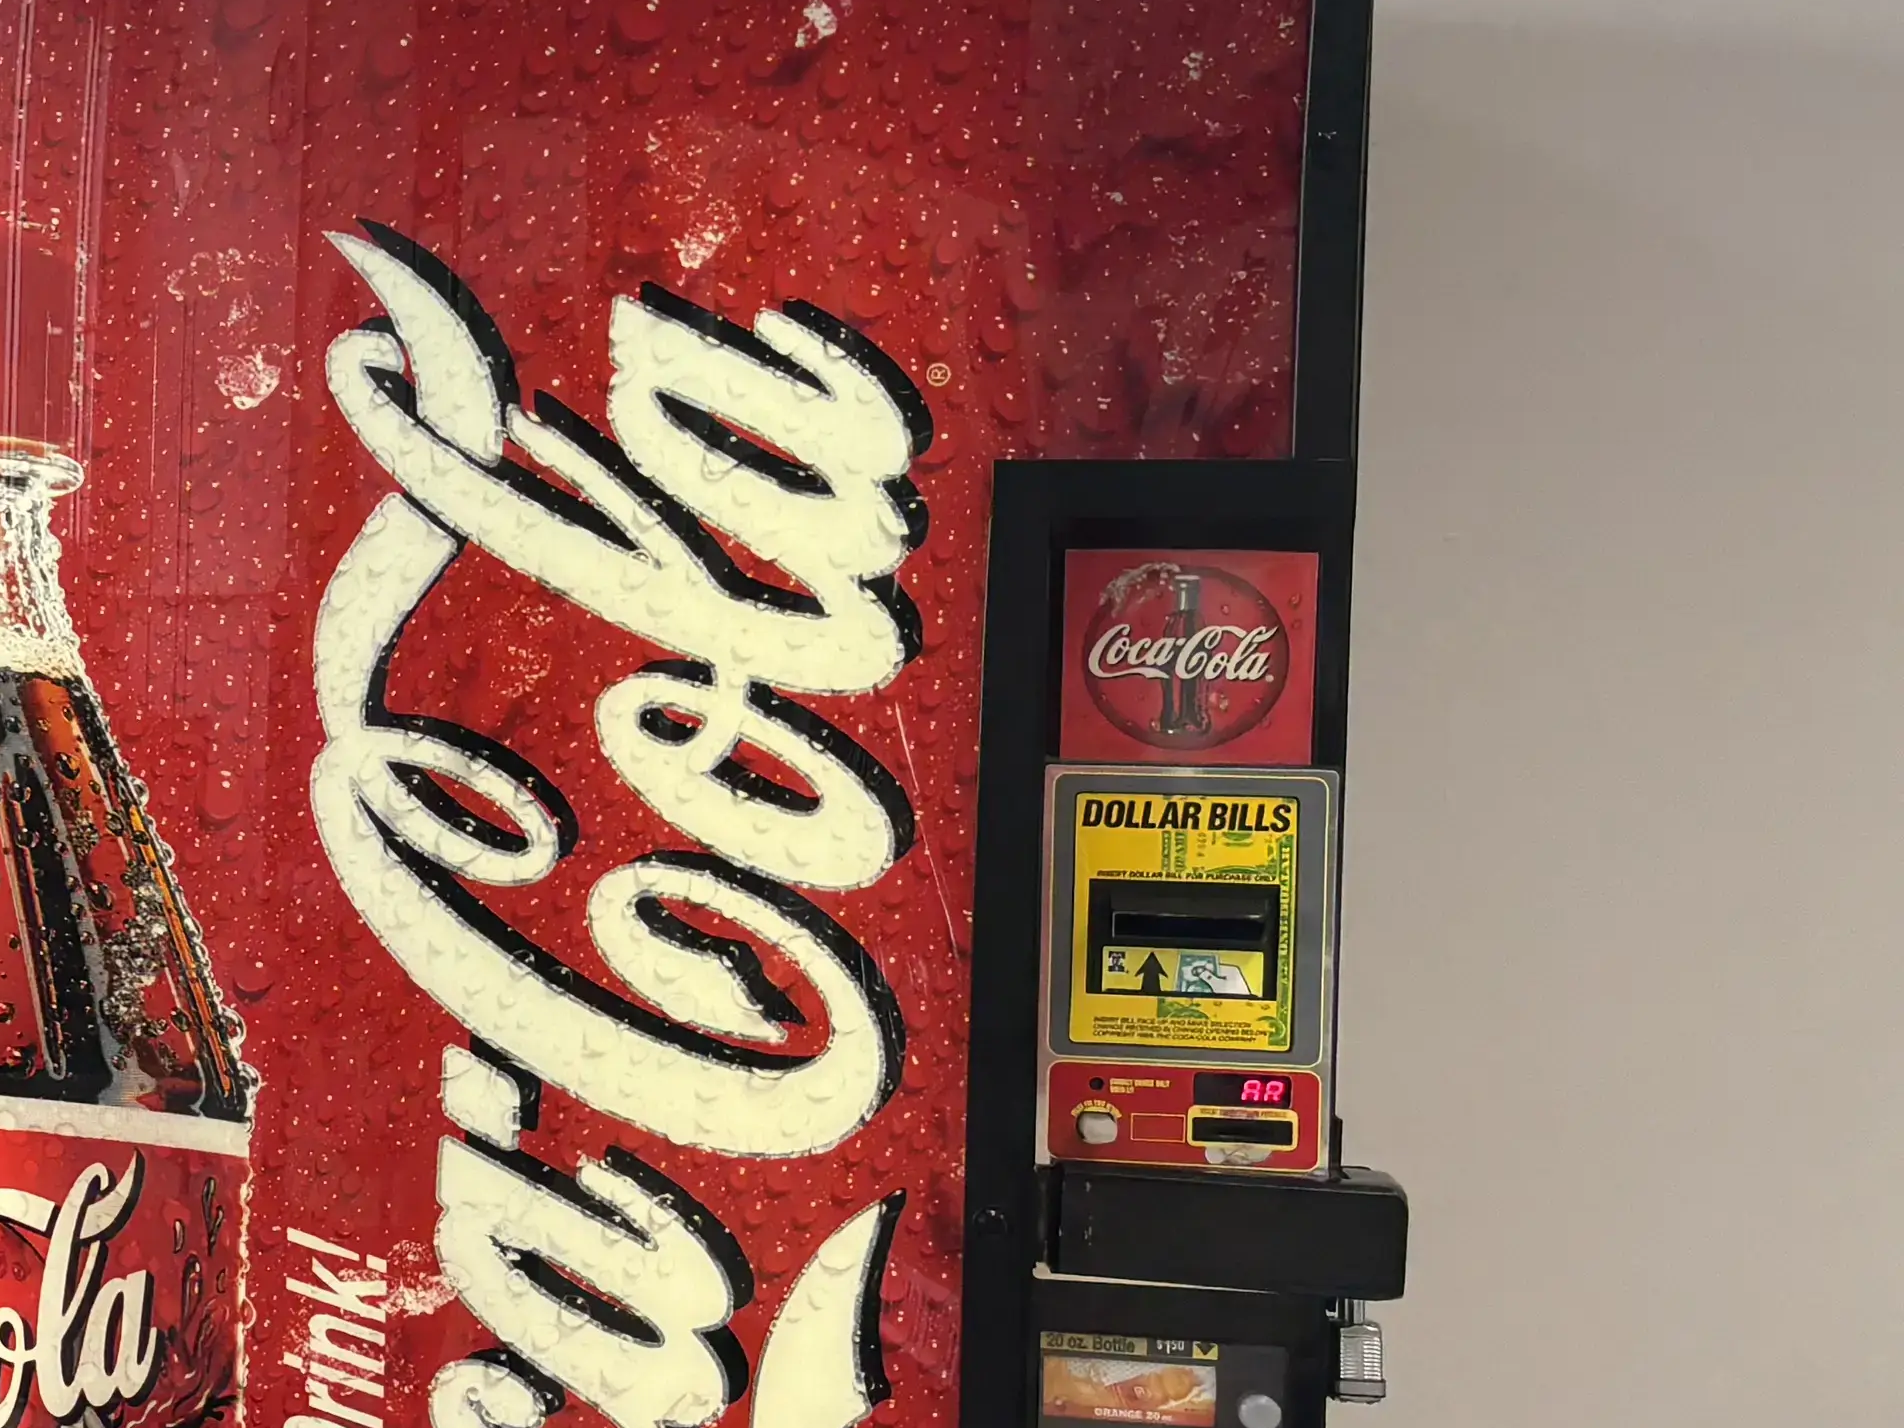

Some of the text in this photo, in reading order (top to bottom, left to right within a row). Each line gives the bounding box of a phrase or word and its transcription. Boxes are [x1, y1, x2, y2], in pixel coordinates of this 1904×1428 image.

[1088, 622, 1280, 682] Coca-Cola
[1082, 799, 1292, 833] DOLLAR BILLS
[1047, 1334, 1136, 1353] 20 oz. Bottle
[1094, 1407, 1161, 1421] ORANGE 20
